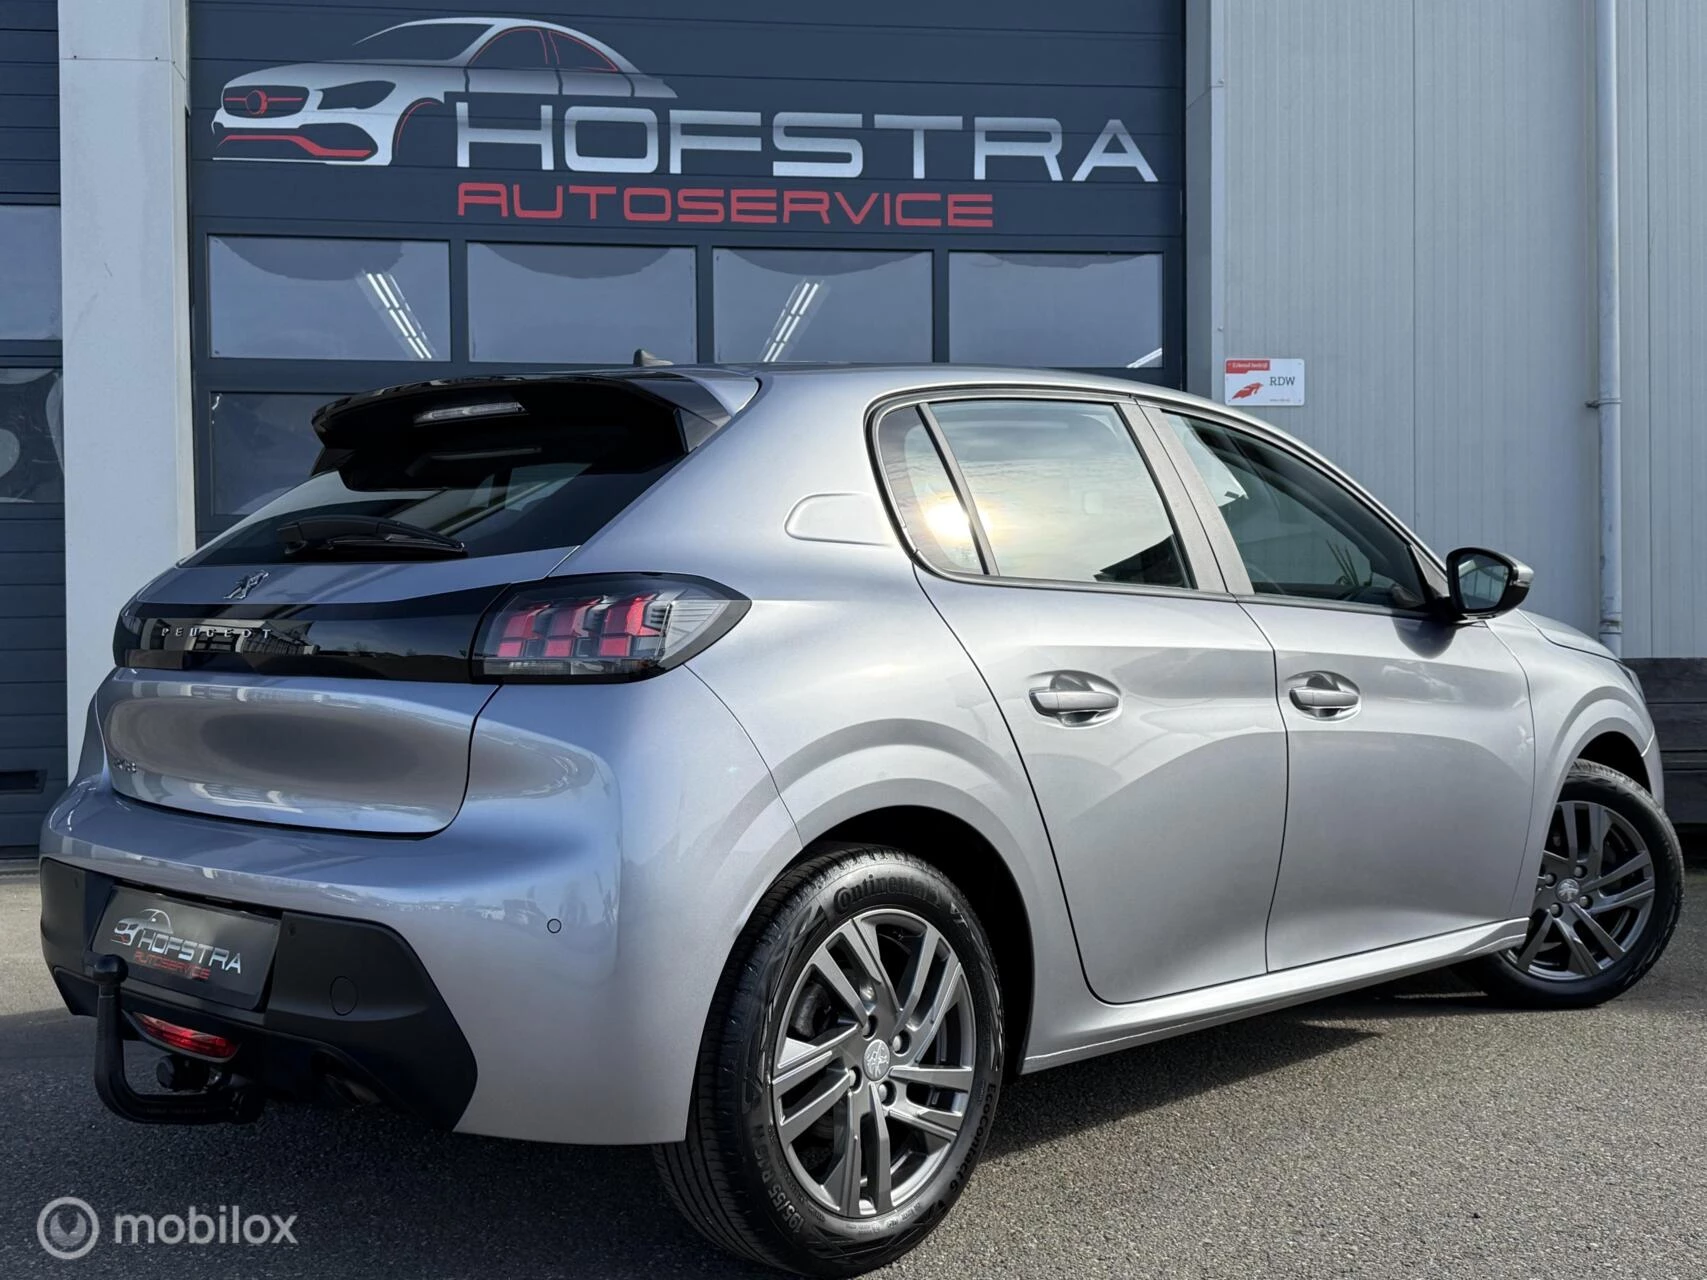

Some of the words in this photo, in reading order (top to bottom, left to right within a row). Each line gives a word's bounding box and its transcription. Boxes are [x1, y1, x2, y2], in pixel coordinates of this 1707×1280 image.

[455, 101, 1158, 183] HOFSTRA
[457, 182, 995, 229] AUTOSERVICE
[1269, 376, 1296, 386] RDW
[137, 929, 242, 975] HOFSTRA
[767, 1183, 805, 1233] 195/55
